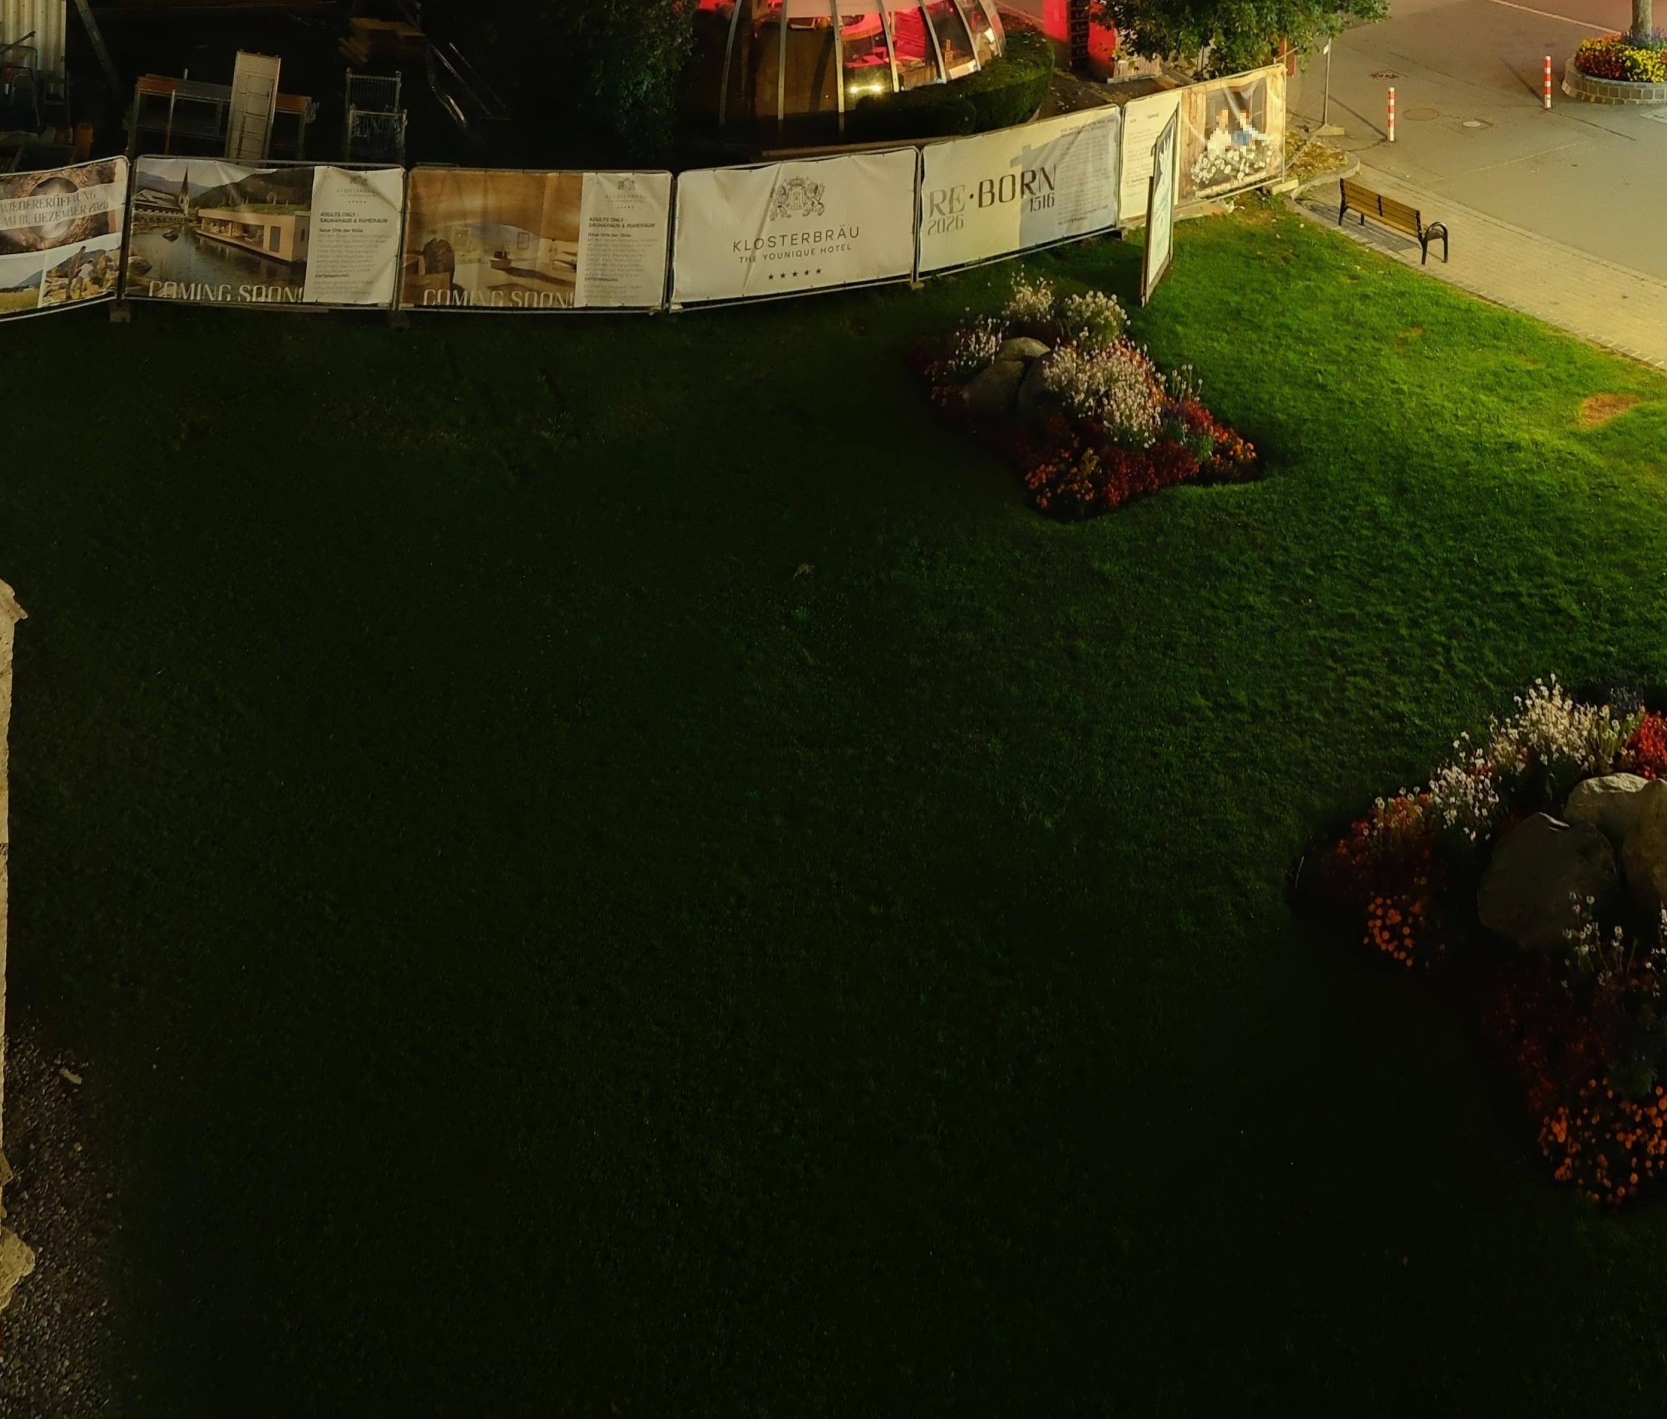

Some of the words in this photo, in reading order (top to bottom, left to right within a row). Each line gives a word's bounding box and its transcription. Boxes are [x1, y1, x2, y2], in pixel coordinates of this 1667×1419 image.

[1030, 192, 1055, 213] 1516
[928, 214, 964, 236] 2026
[733, 224, 860, 253] KLOSTERBRÄU
[739, 256, 757, 264] THE
[763, 248, 816, 261] YOUNIQUE
[820, 244, 852, 254] HOTEL
